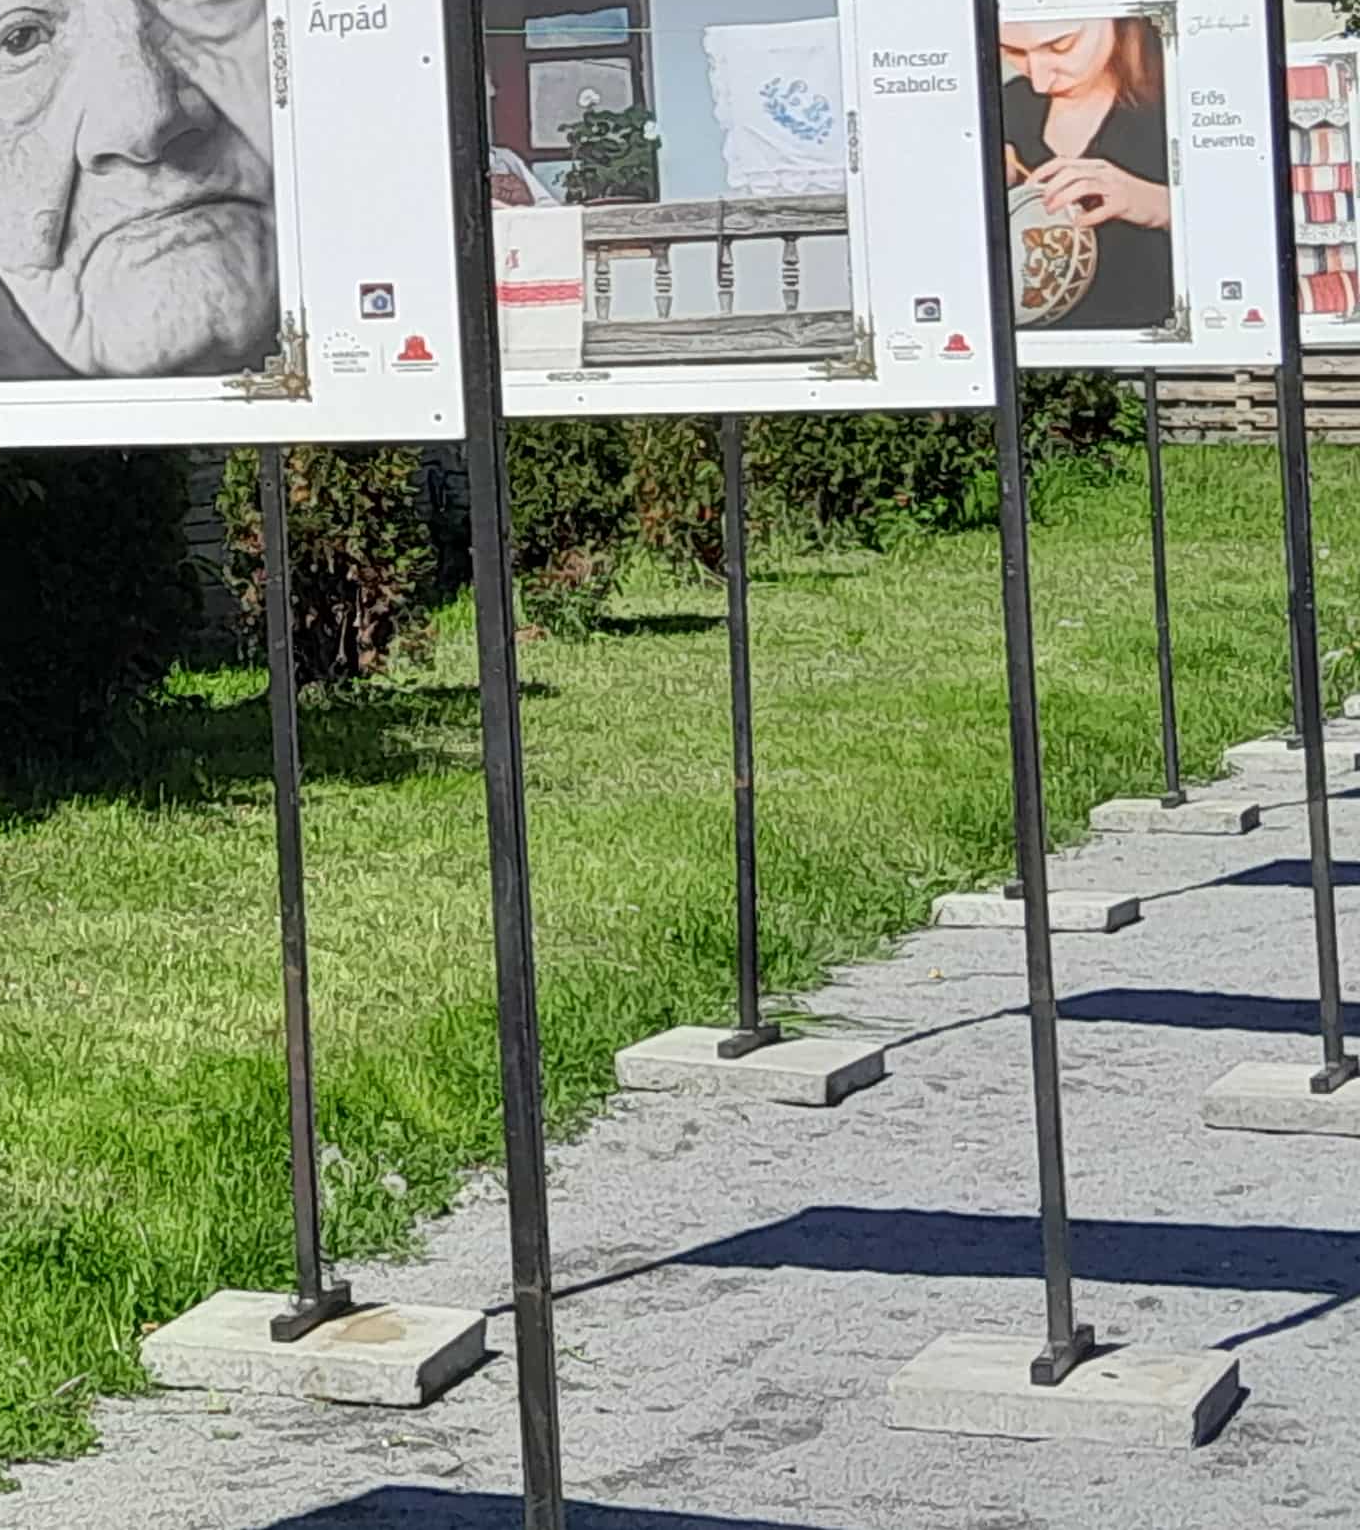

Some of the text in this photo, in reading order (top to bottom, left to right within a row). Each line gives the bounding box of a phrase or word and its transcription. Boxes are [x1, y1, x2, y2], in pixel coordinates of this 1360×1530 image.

[309, 2, 388, 38] Árpád
[873, 75, 958, 95] Szabolcs
[1192, 111, 1242, 127] Zoltán
[1192, 134, 1256, 149] Levente
